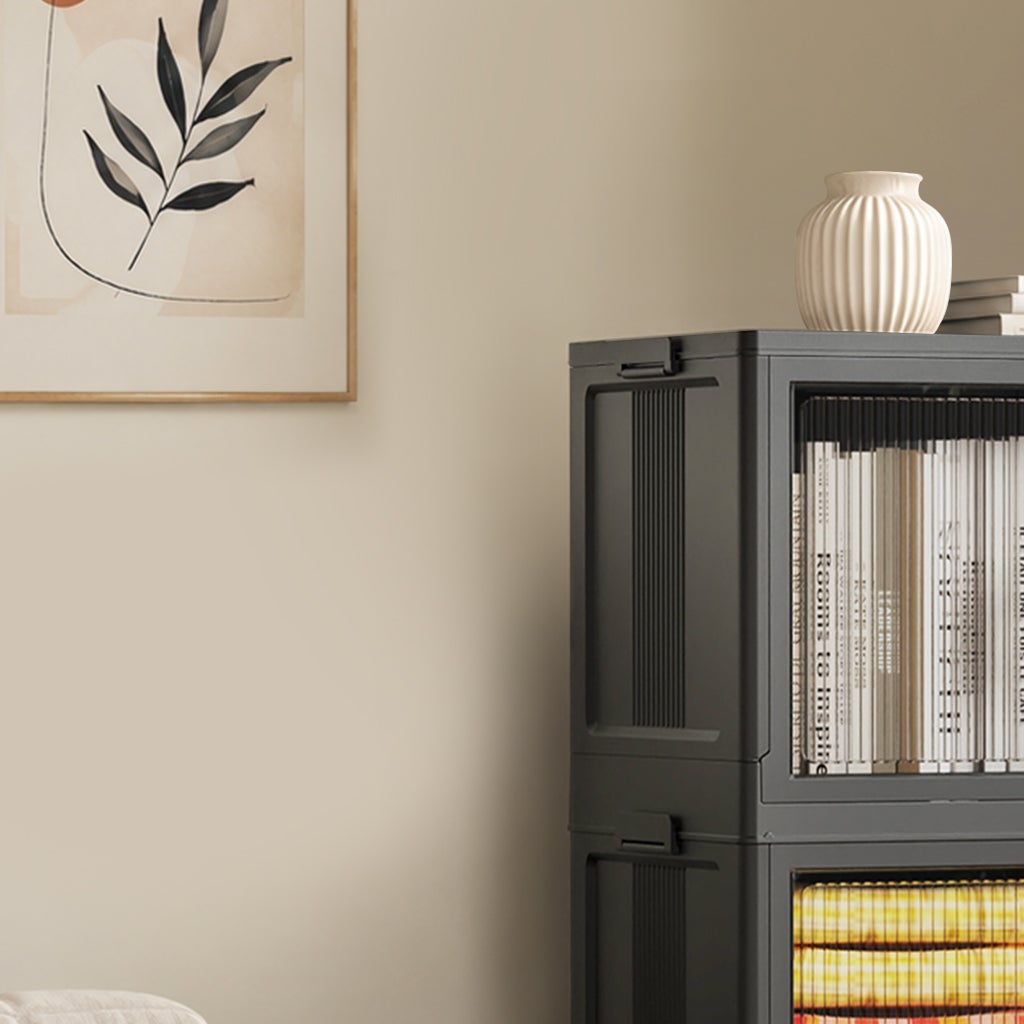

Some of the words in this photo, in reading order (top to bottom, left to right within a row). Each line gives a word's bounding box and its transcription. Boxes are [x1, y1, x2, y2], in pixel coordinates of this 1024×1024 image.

[816, 552, 832, 642] Rooms
[877, 590, 894, 674] LEADERSHIP
[816, 651, 832, 678] to
